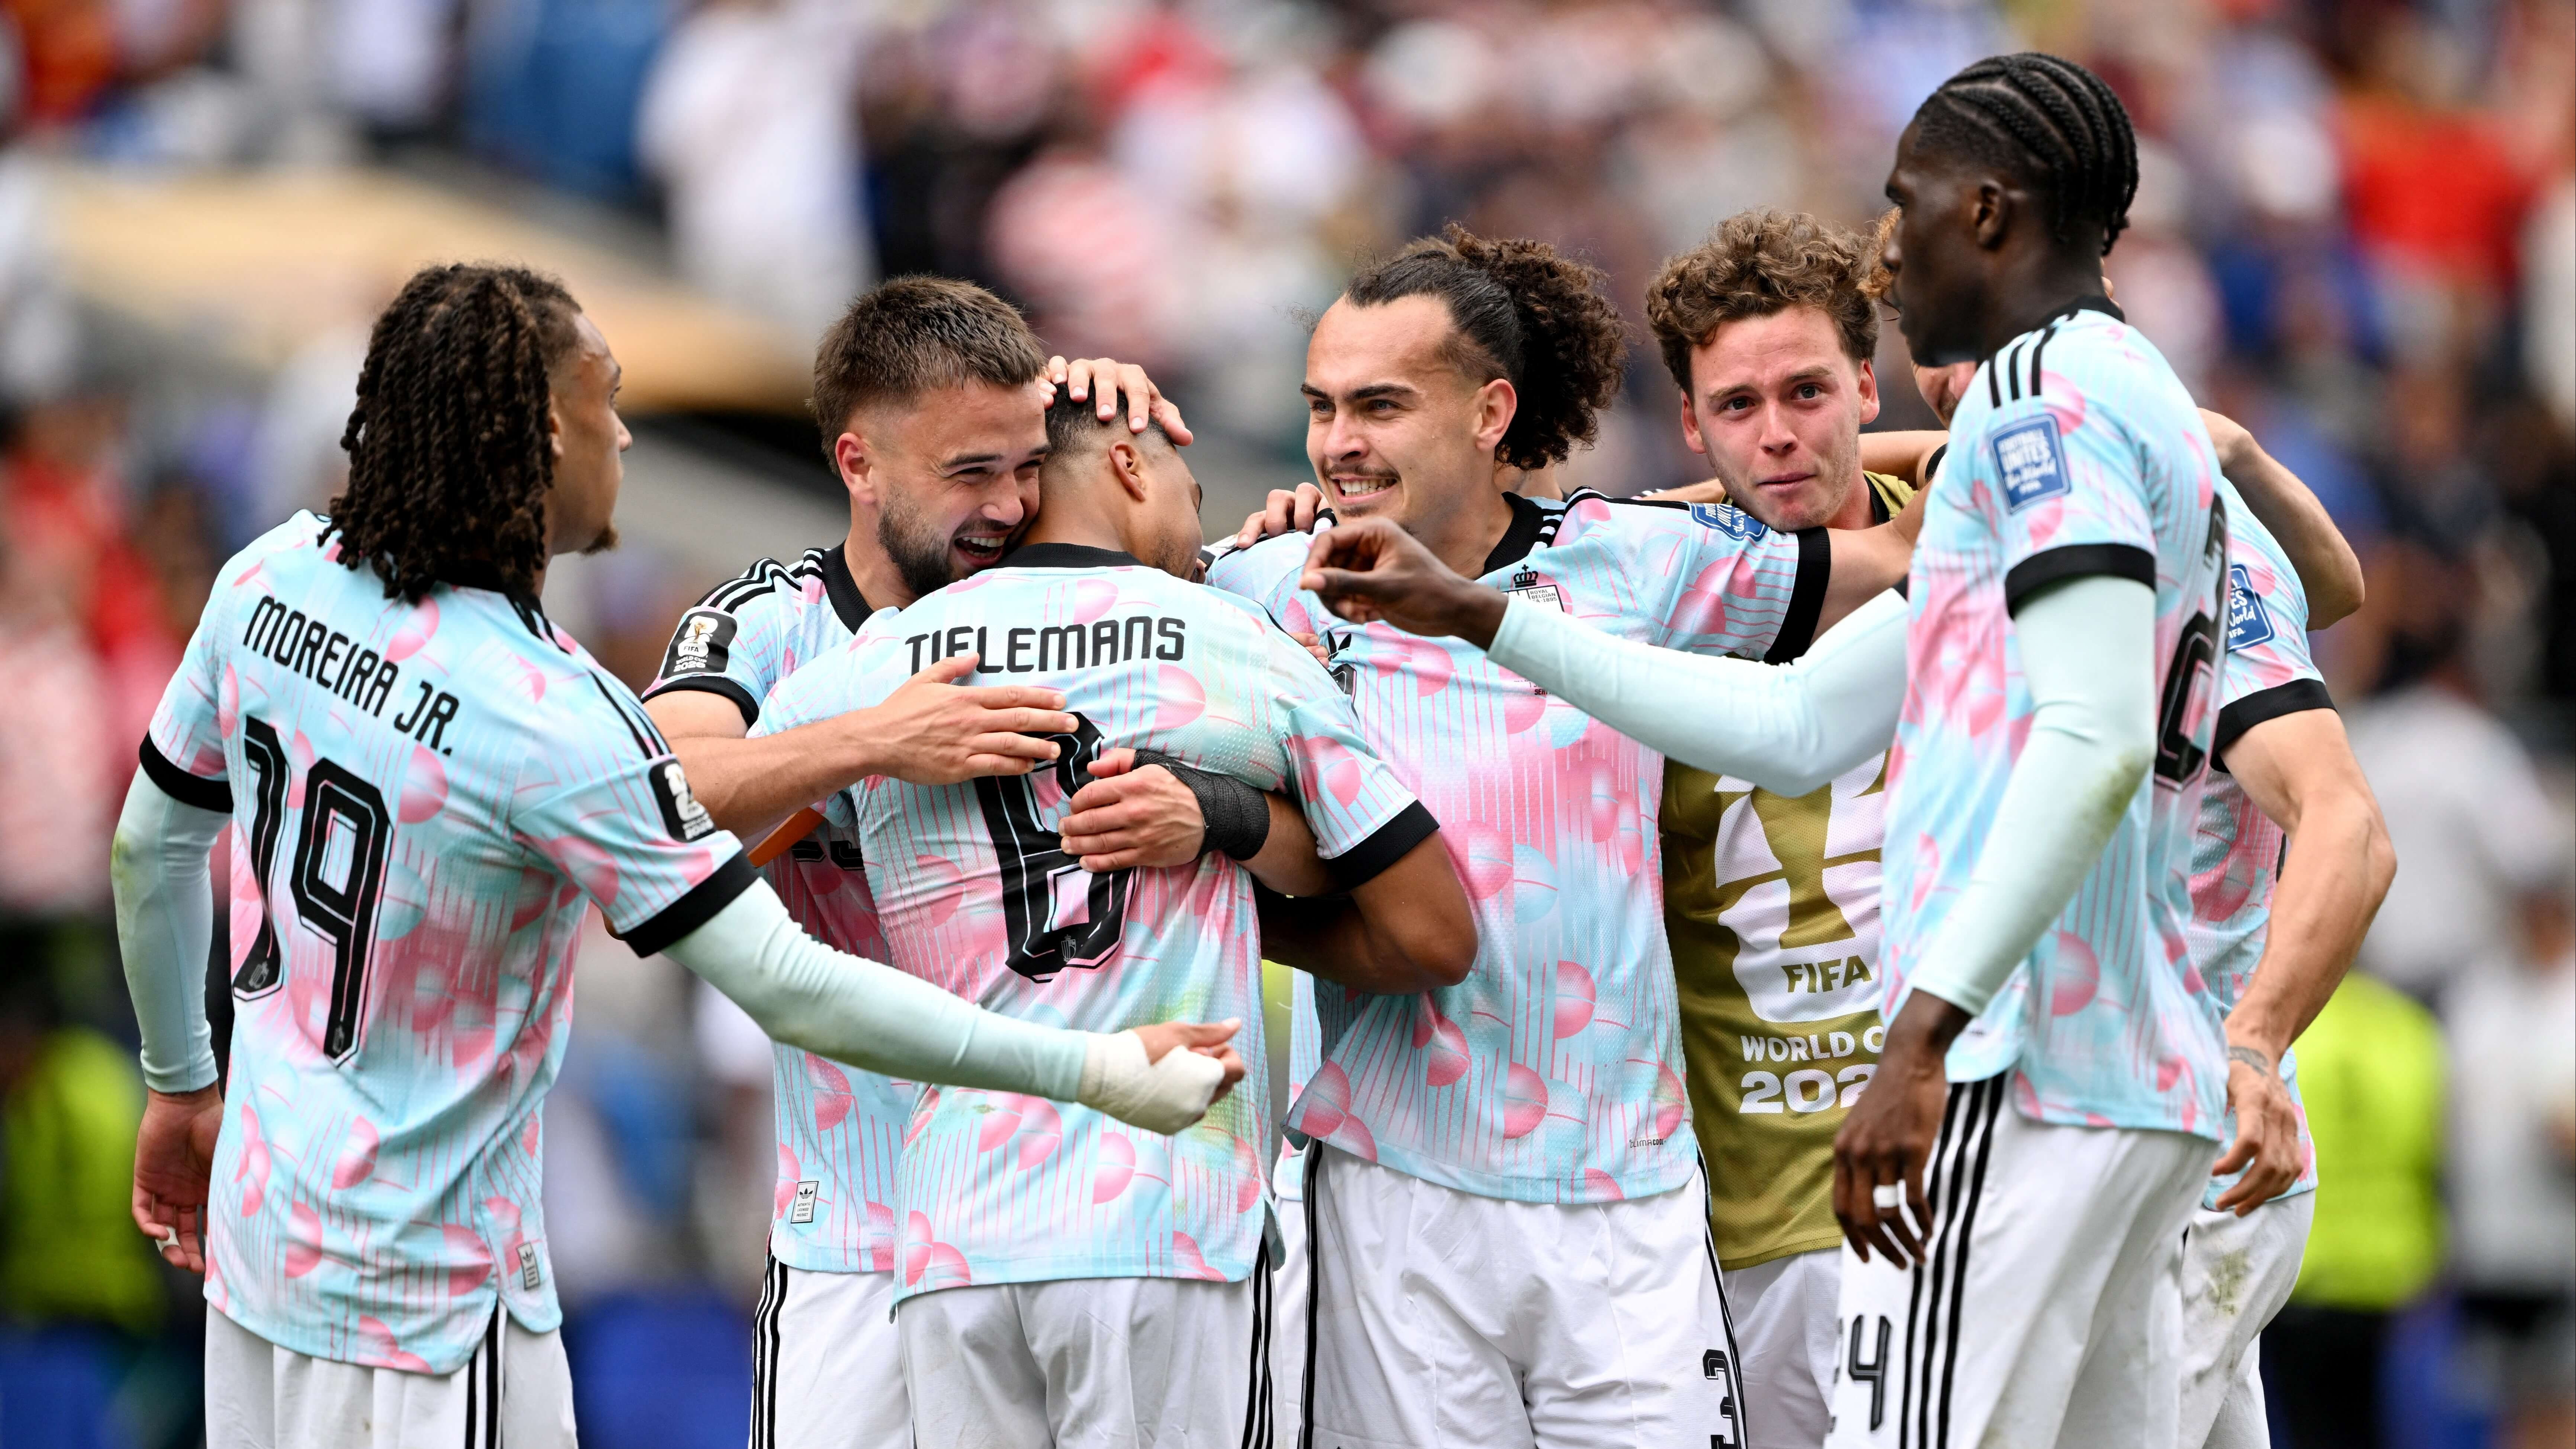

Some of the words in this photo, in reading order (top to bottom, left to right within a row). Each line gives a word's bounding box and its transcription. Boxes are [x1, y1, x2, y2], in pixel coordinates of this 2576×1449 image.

[1703, 503, 1717, 519] FOOT
[1732, 517, 1744, 533] the
[905, 616, 1186, 676] TIELEMANS
[2228, 627, 2245, 638] IFA
[243, 595, 398, 718] MOREIRA
[394, 680, 459, 756] JR.
[673, 661, 706, 672] 2026
[676, 656, 694, 665] WORLD
[232, 714, 394, 1068] 19
[1781, 955, 1873, 993] FIFA
[1741, 1032, 1855, 1062] WORLD
[1739, 1064, 1879, 1113] 202
[1830, 1315, 1892, 1434] 4
